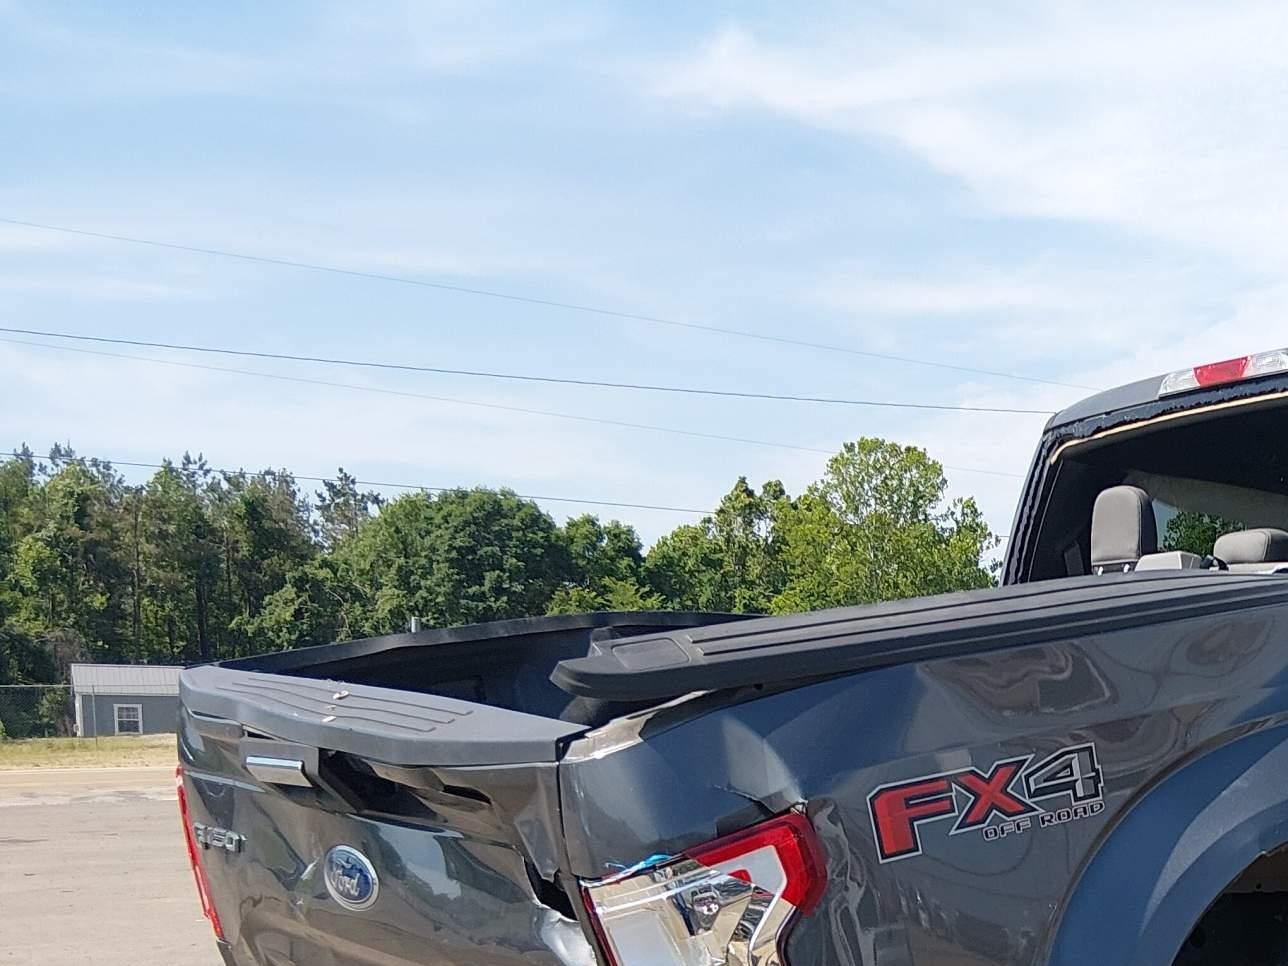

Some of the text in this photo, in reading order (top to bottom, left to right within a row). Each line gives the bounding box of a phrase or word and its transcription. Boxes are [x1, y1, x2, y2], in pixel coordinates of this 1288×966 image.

[866, 742, 1104, 864] FX4
[983, 800, 1105, 841] OFF ROAD
